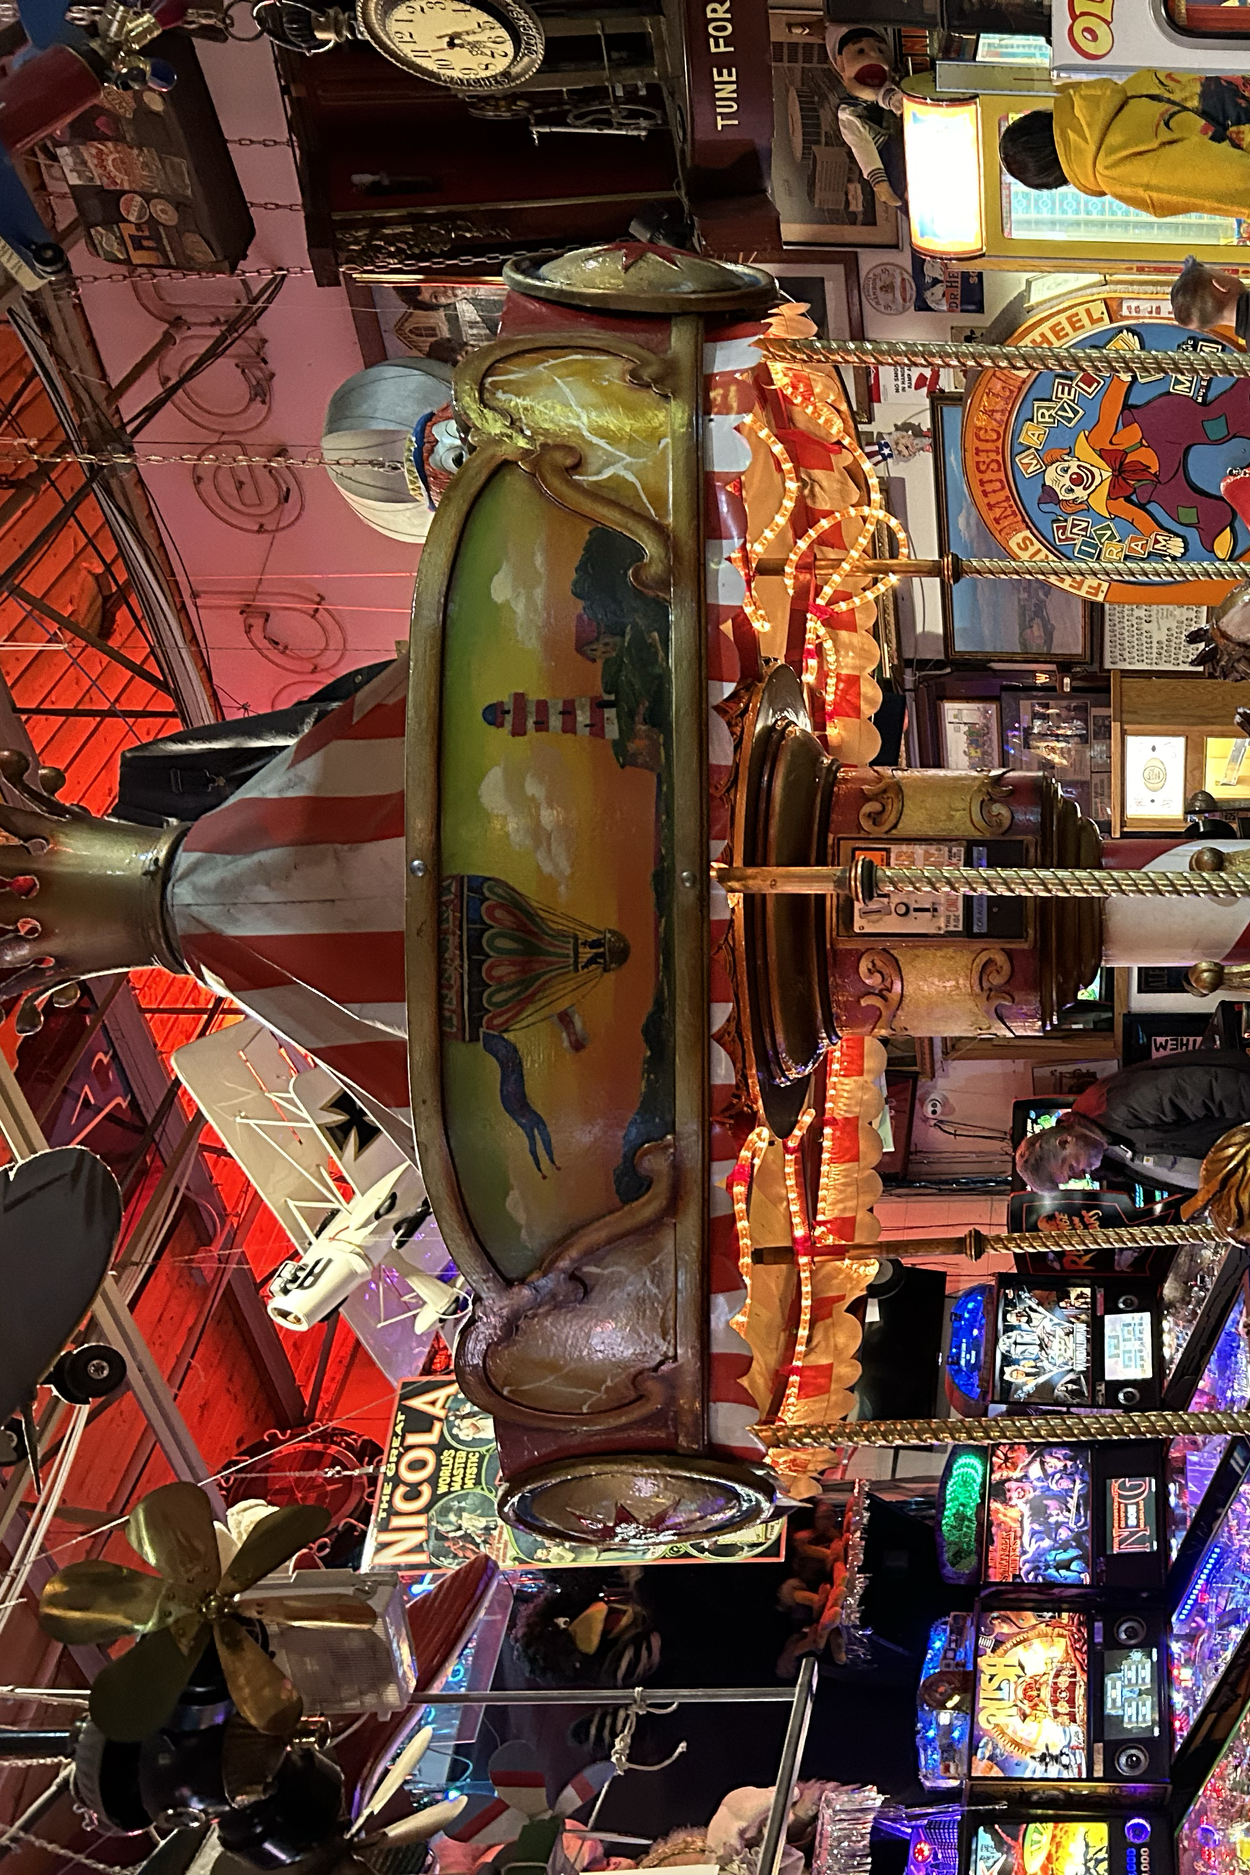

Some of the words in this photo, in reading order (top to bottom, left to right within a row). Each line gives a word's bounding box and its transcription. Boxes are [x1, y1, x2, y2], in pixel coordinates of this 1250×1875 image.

[405, 5, 427, 14] 2
[425, 1, 447, 10] 3
[451, 6, 472, 19] 4
[476, 20, 496, 31] 5
[509, 9, 538, 58] CLOCKS
[705, 0, 735, 53] FOR
[393, 31, 417, 44] 12
[486, 35, 508, 45] 6
[410, 49, 432, 59] 11
[490, 50, 509, 59] 7
[434, 58, 456, 71] 10
[459, 67, 479, 76] 9
[477, 62, 498, 71] 8
[712, 67, 739, 131] TUNE
[945, 271, 959, 290] HE
[948, 290, 959, 309] DR.
[894, 383, 901, 393] NO
[973, 383, 1018, 525] MUSICAL
[1014, 533, 1101, 597] FEIS
[1075, 1323, 1088, 1371] MANDALORIAN
[377, 1481, 393, 1522] THE
[386, 1410, 406, 1477] GREAT
[436, 1449, 456, 1494] WORLD'S
[450, 1450, 468, 1491] MASTER
[463, 1451, 480, 1489] MYSTIC
[977, 1655, 1025, 1730] RUSH
